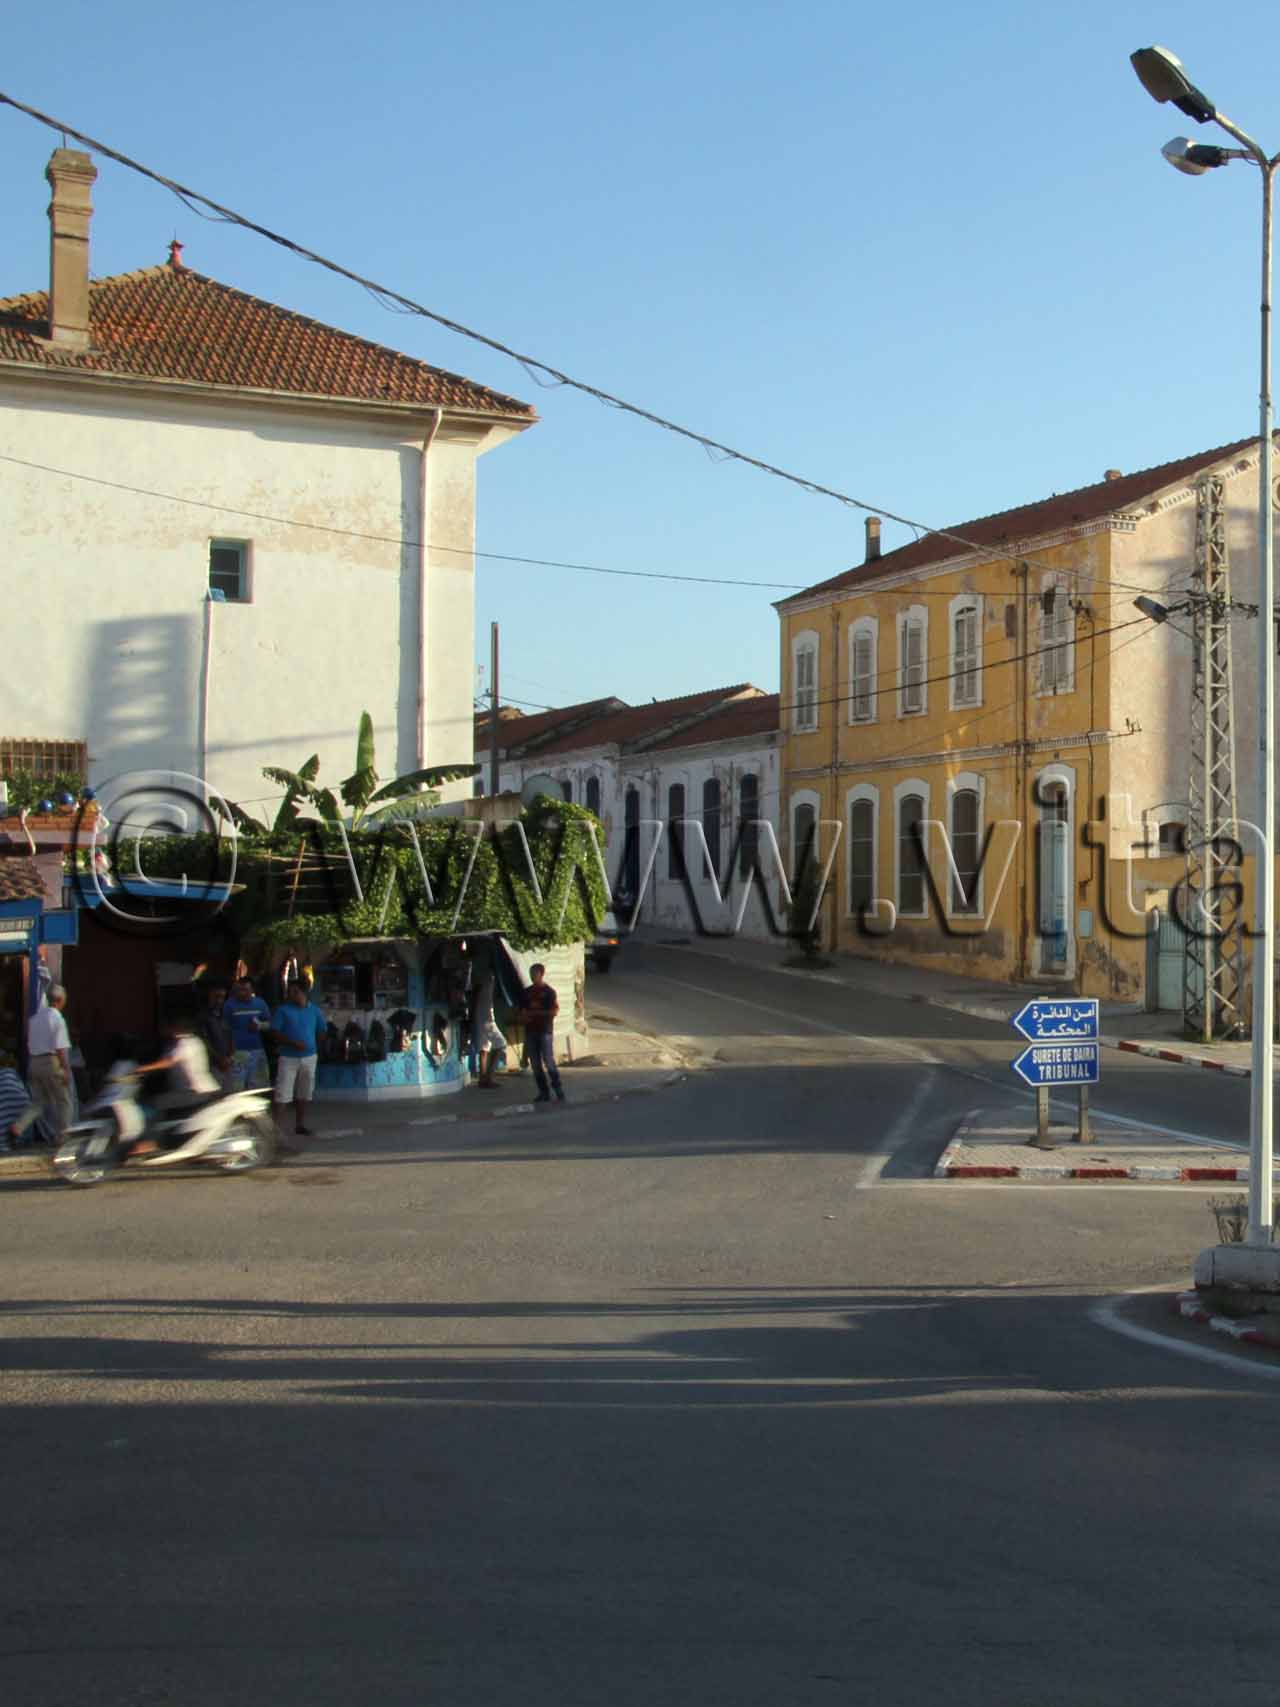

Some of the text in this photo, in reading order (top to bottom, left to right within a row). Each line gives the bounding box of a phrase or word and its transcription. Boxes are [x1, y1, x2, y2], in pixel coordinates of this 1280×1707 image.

[1032, 1006, 1071, 1022] الدائرة
[1037, 1023, 1091, 1036] المحكمة
[1062, 1047, 1073, 1062] DE
[1039, 1064, 1090, 1080] TRIBUNAL
